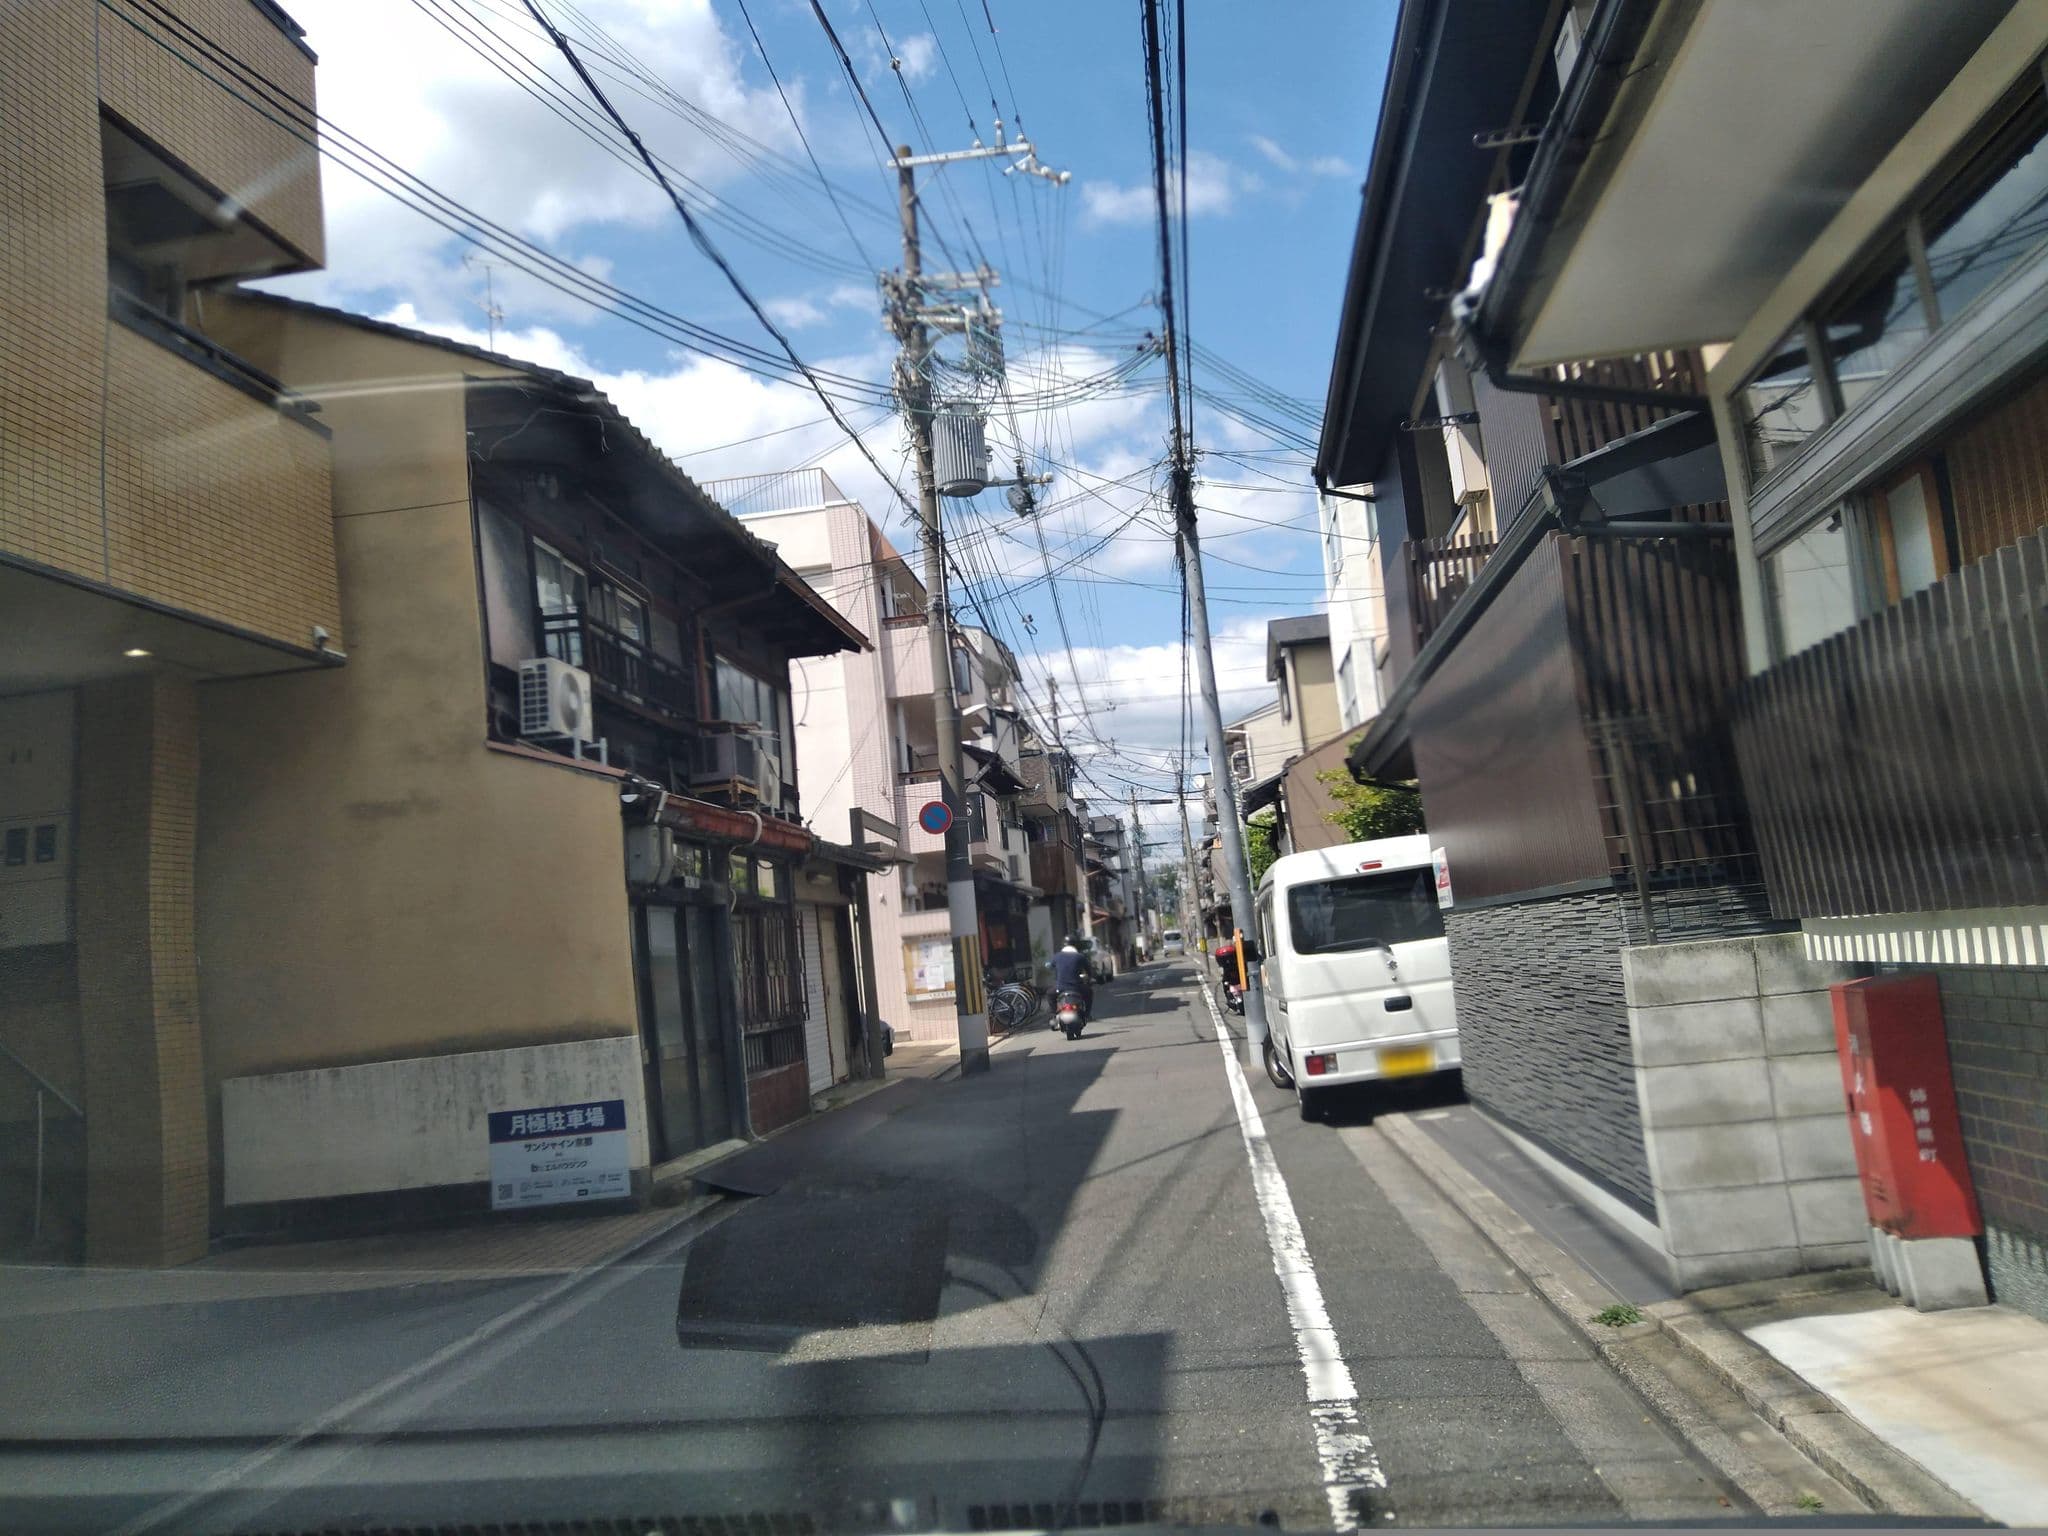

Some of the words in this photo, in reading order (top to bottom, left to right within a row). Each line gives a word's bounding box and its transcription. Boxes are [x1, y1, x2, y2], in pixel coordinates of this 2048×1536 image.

[510, 1107, 606, 1136] 月極駐車場
